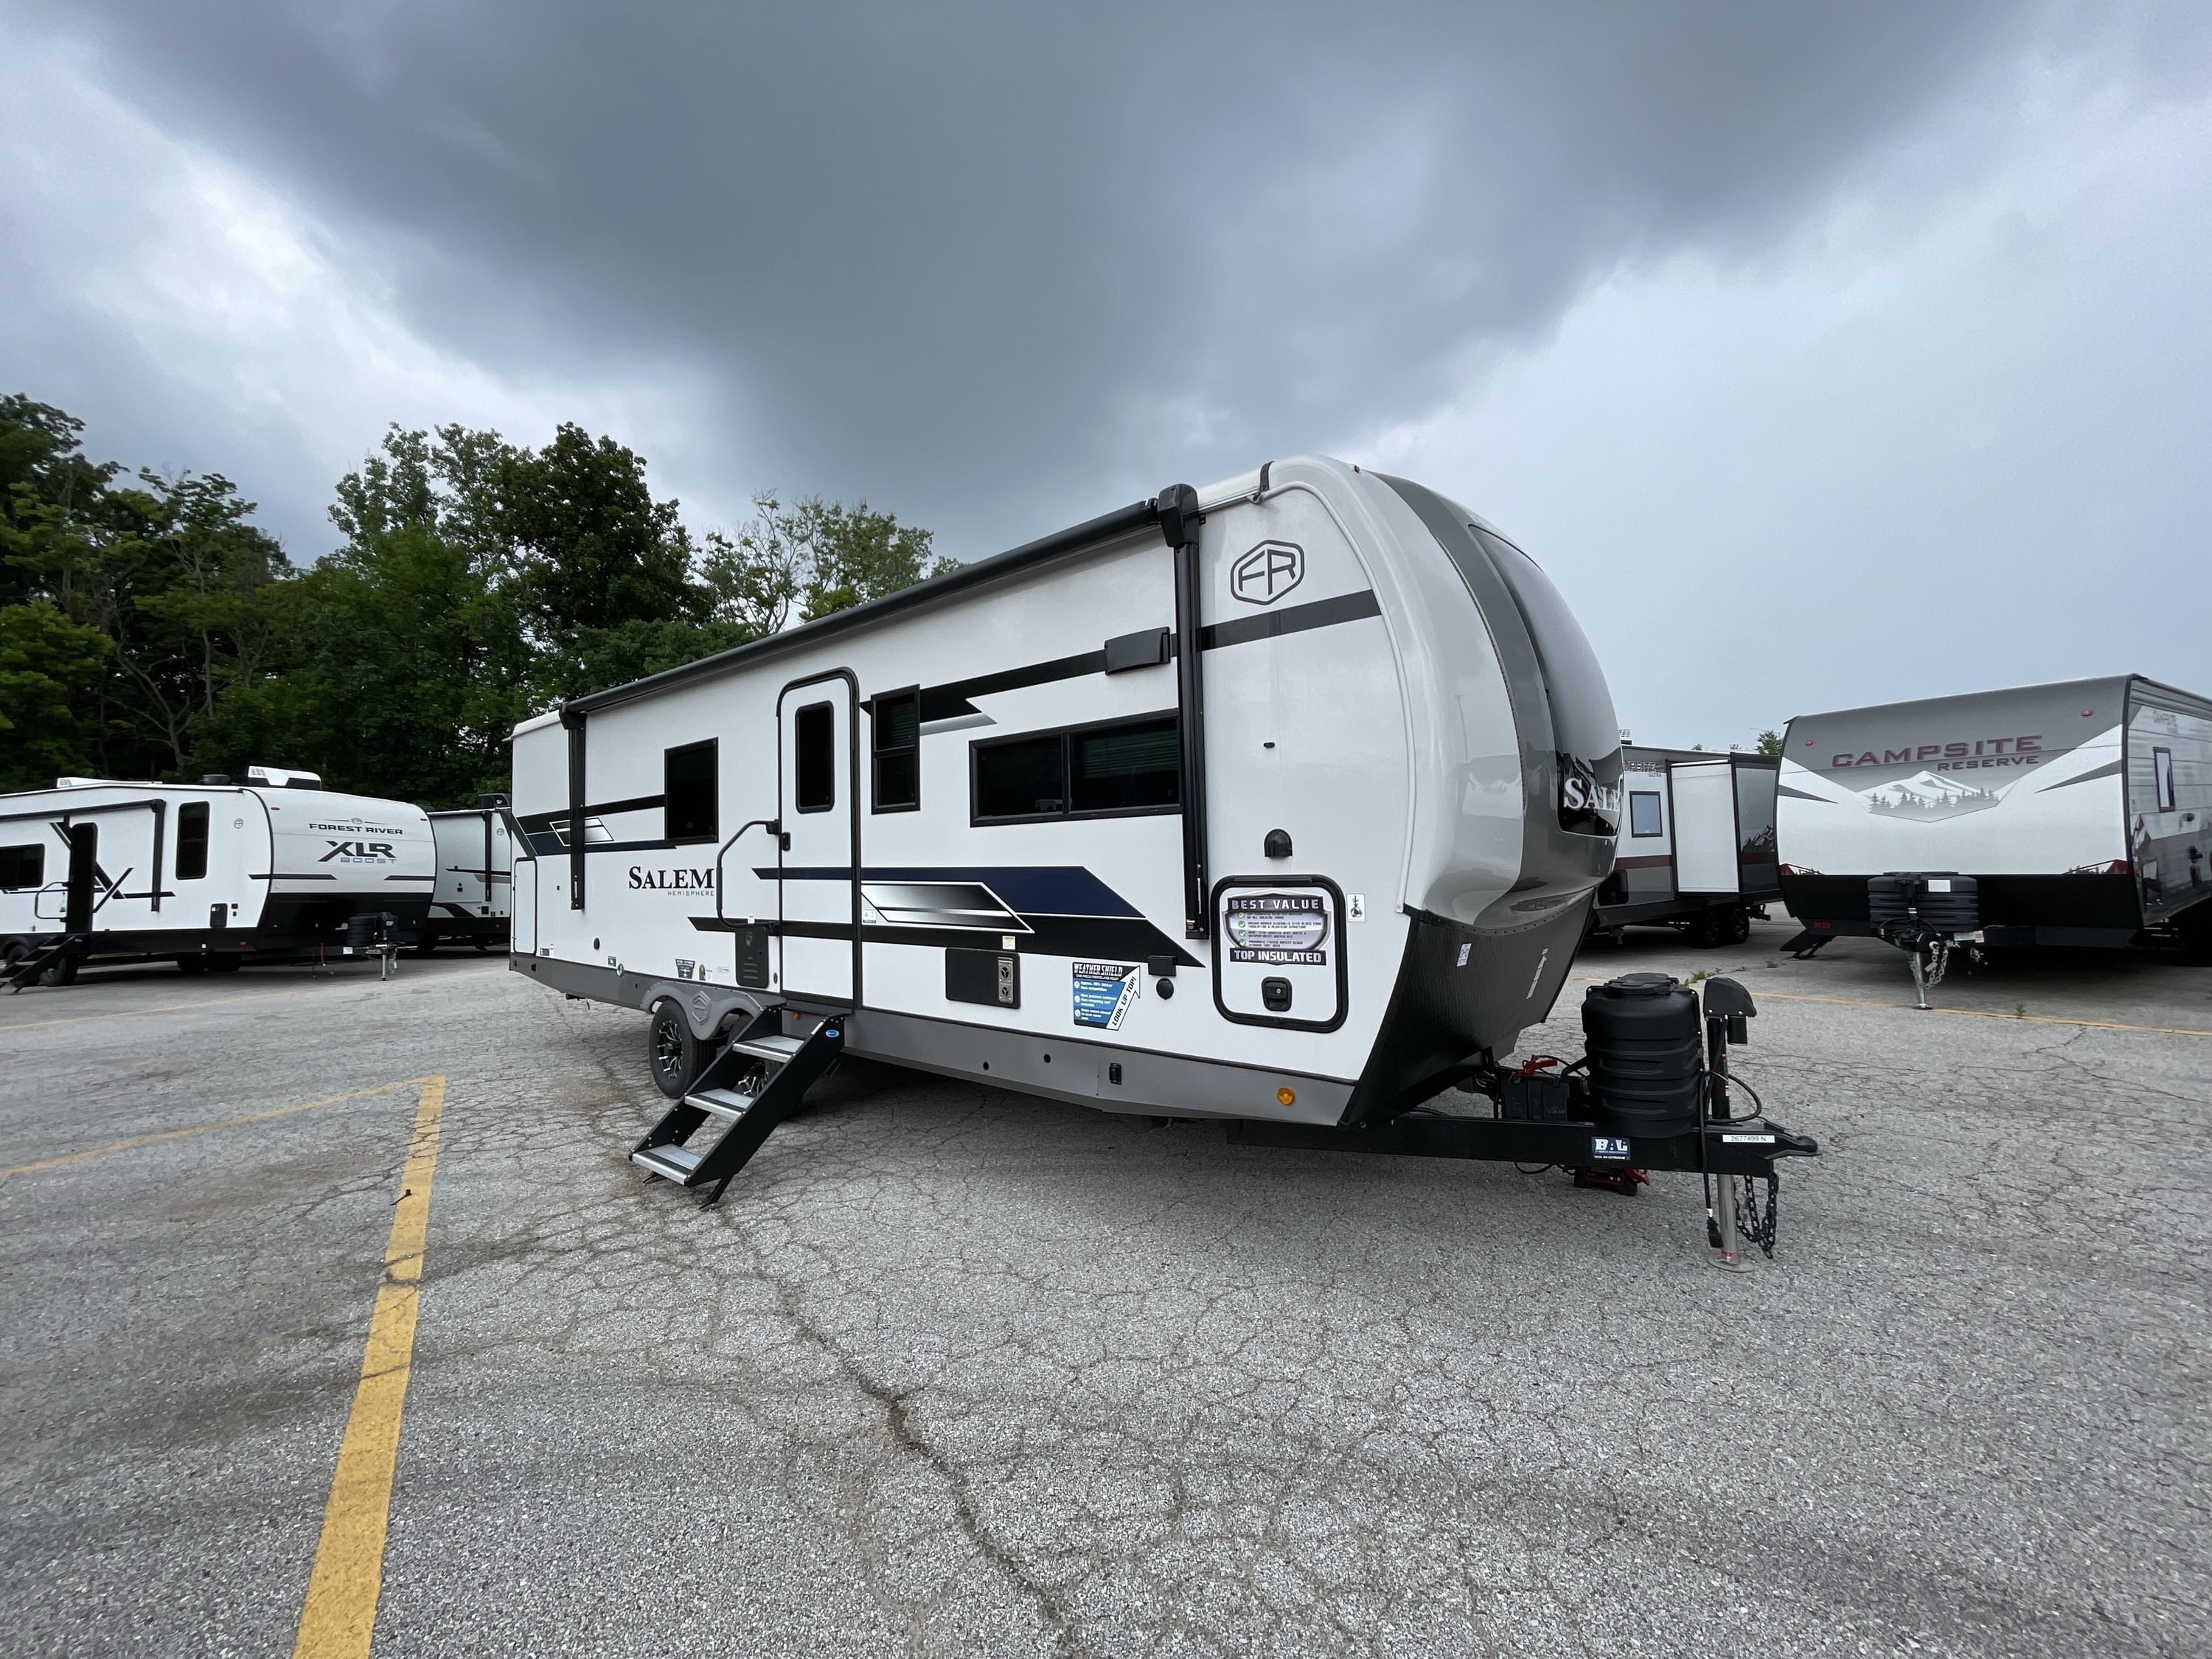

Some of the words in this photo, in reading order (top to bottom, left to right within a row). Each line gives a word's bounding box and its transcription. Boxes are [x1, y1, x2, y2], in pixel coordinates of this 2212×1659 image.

[1832, 735, 2042, 768] CAMPSITE
[1937, 756, 2039, 771] RESERVE
[308, 823, 363, 832] FOREST
[317, 840, 397, 862] XLR
[628, 866, 714, 889] SALEM
[1231, 900, 1265, 910] BEST
[1273, 899, 1319, 910] VALUE
[1234, 950, 1255, 960] TOP
[1258, 950, 1321, 963] INSULATED
[1112, 1008, 1124, 1026] LOOK
[1121, 994, 1128, 1006] UP
[1126, 976, 1137, 993] TOP!
